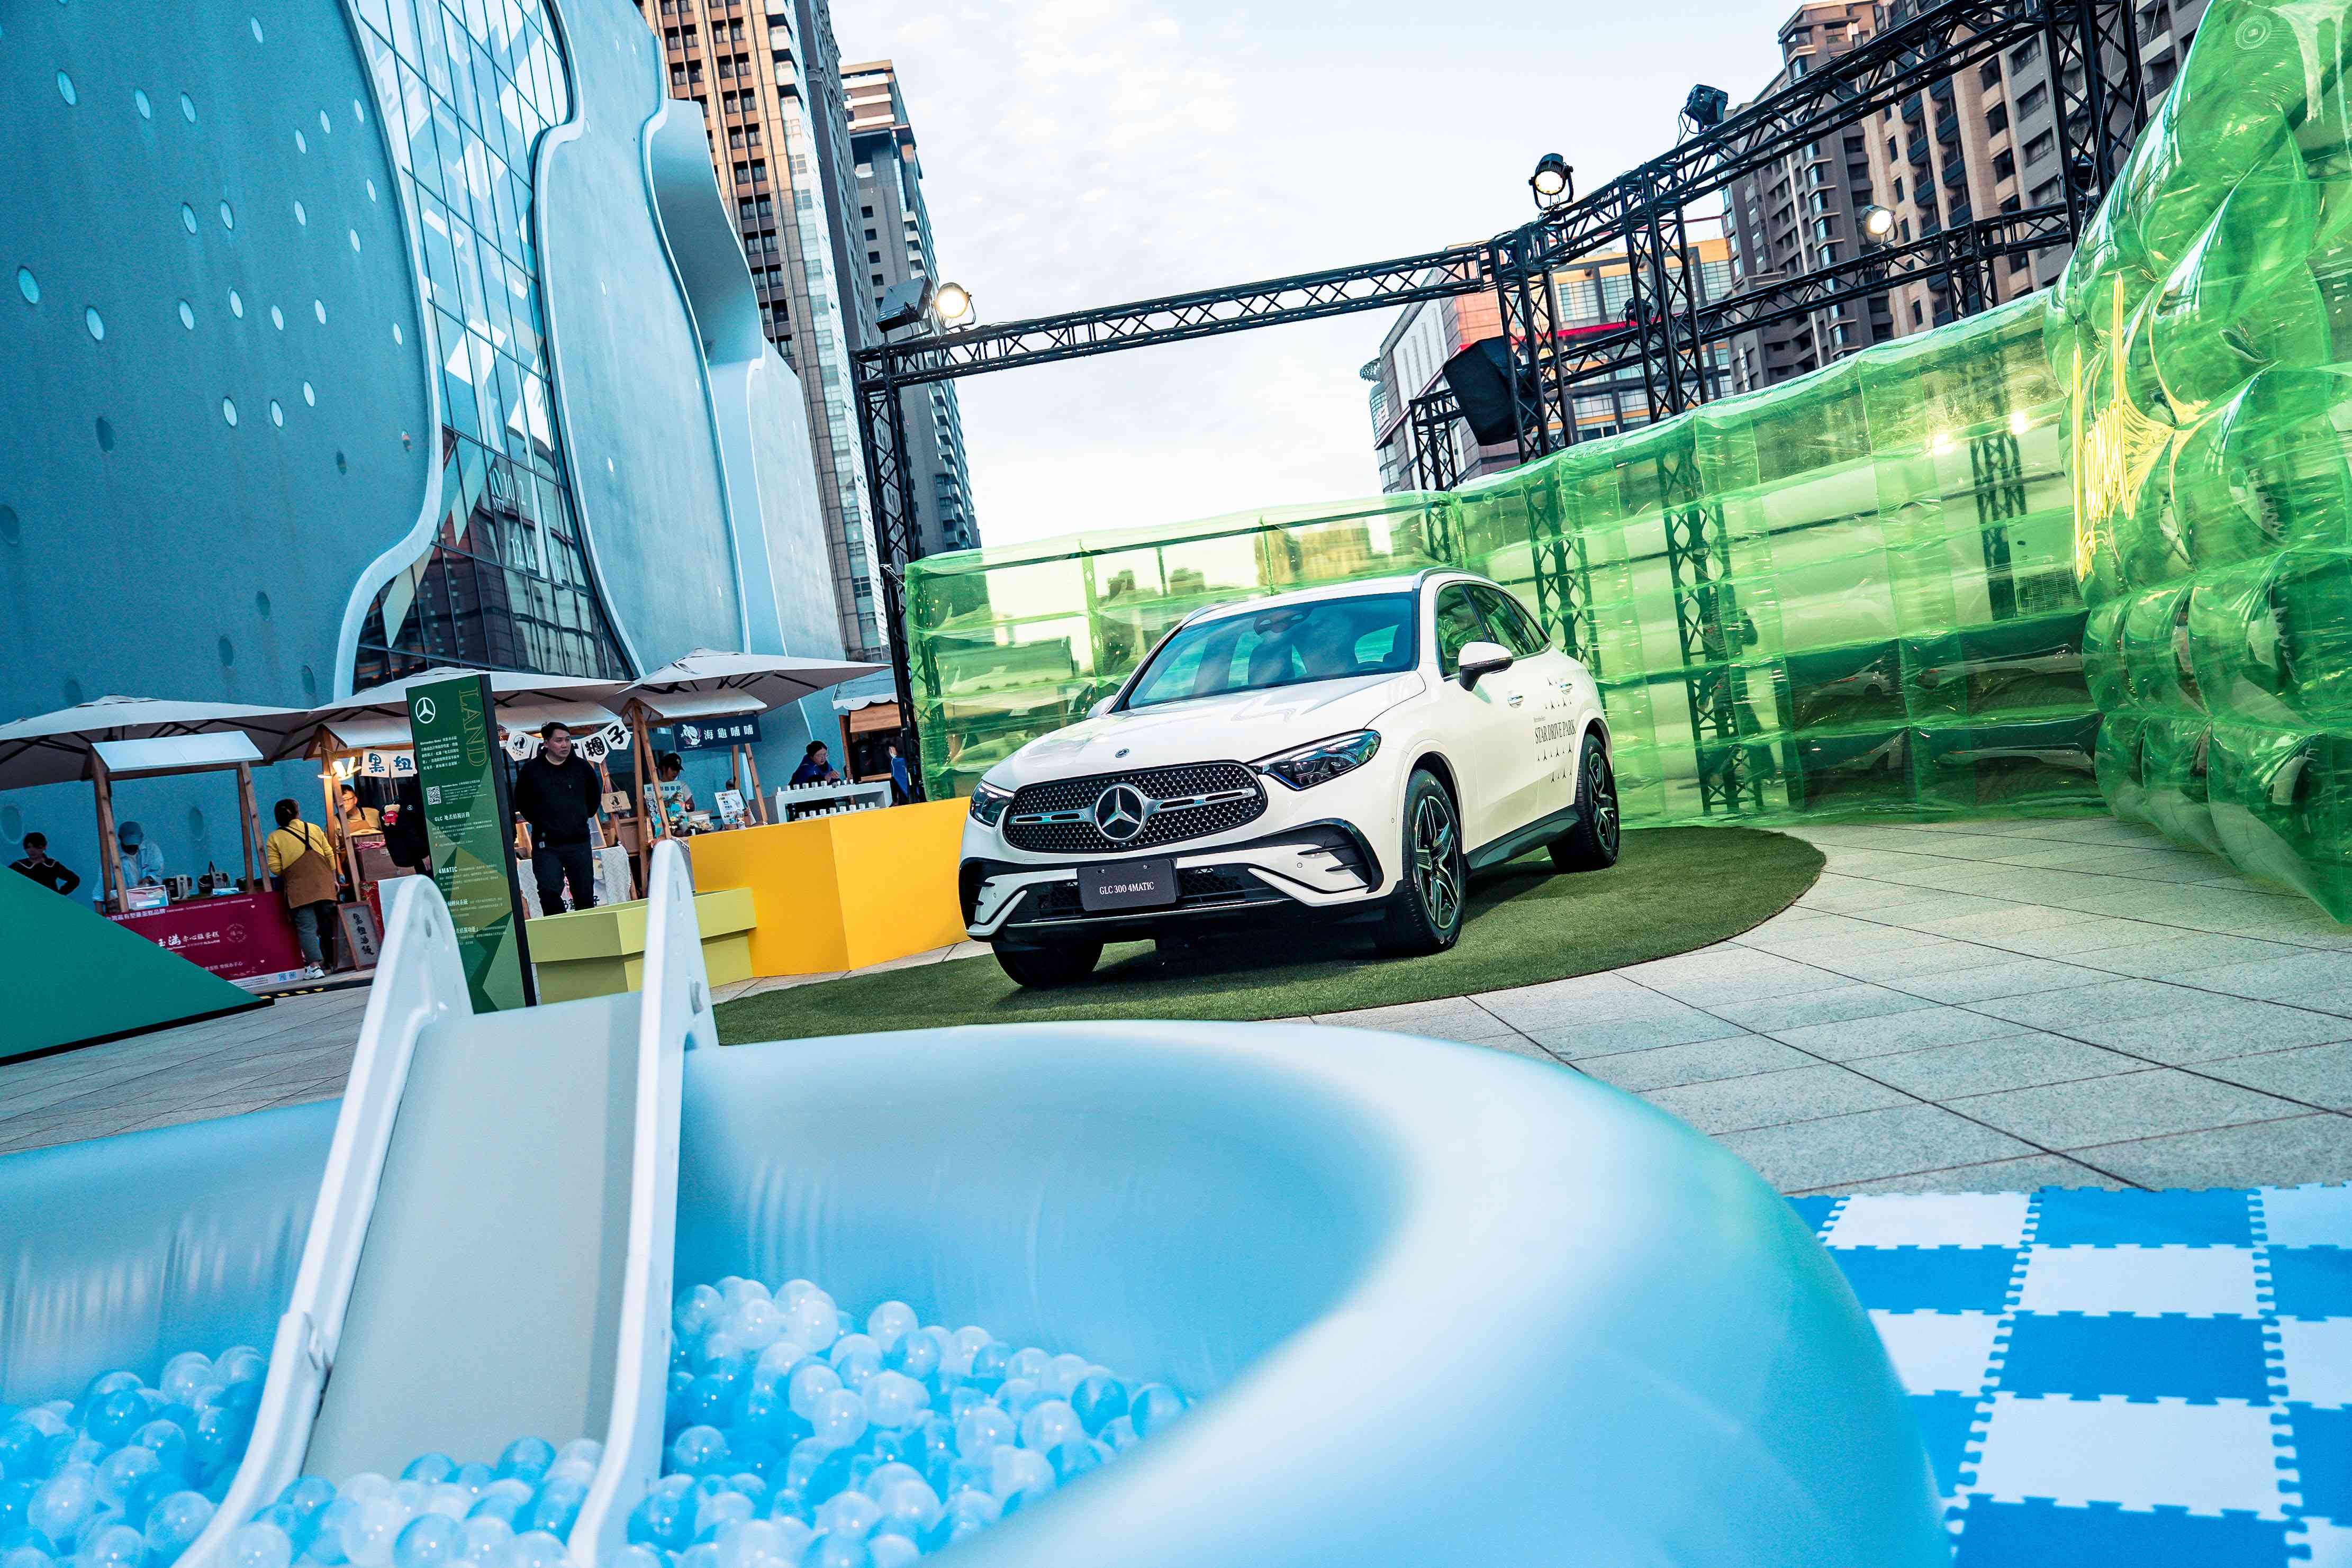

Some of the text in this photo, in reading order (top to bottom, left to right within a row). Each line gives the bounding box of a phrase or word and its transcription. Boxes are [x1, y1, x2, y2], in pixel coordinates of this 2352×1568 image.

[1535, 719, 1576, 744] STAR DRIVE PARK
[1099, 881, 1154, 895] GLC 300 4MATIC
